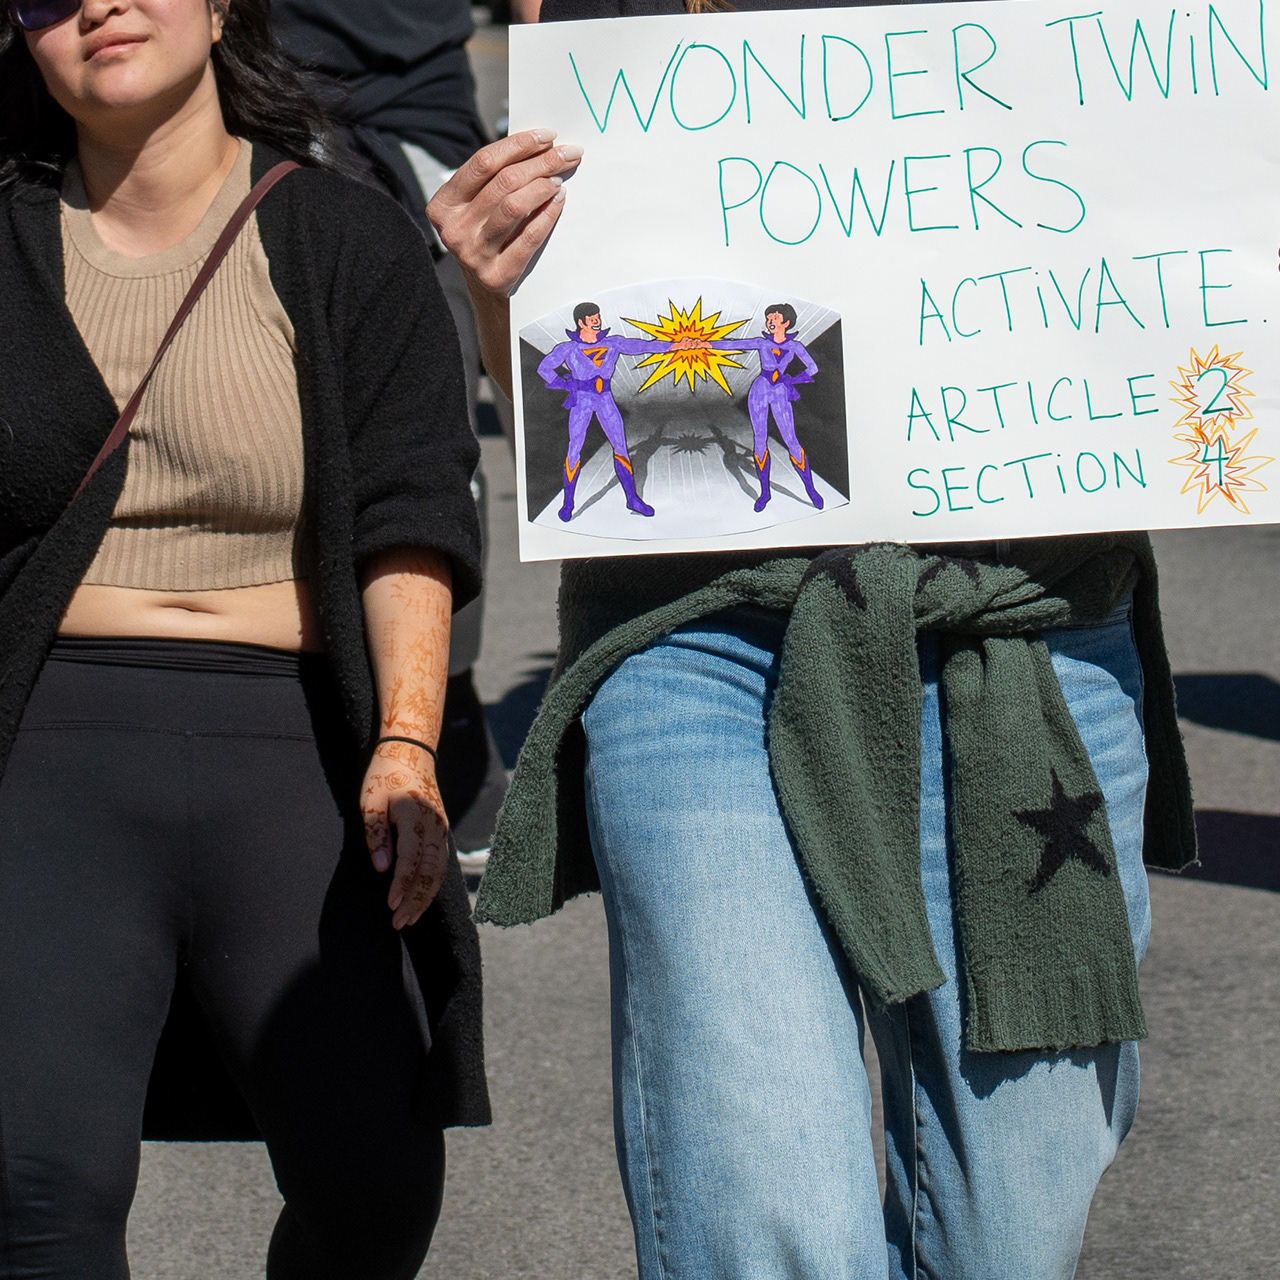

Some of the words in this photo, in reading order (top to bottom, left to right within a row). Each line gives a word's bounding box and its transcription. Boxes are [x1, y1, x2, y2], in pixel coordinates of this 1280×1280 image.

[568, 23, 1013, 135] WONDER
[717, 140, 1086, 247] POWERS
[906, 373, 1160, 443] ARTICLE
[1197, 367, 1234, 415] 2
[1201, 437, 1231, 487] 4
